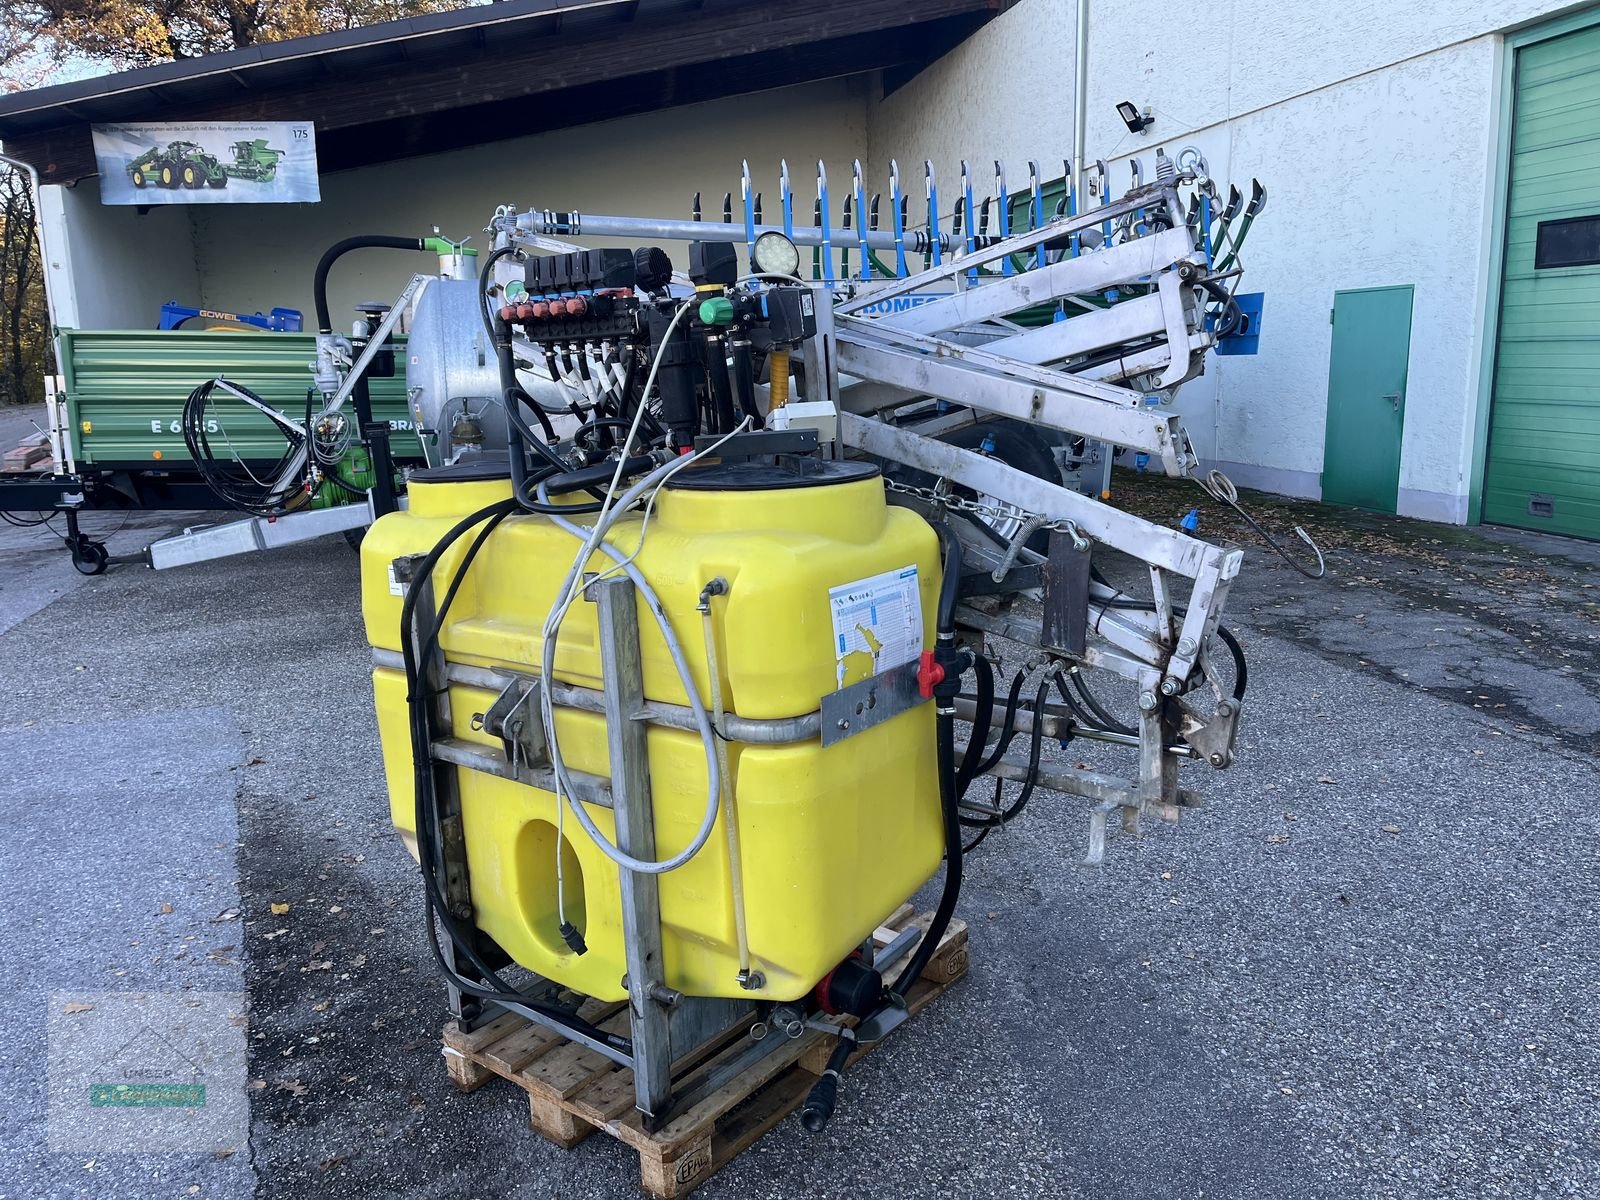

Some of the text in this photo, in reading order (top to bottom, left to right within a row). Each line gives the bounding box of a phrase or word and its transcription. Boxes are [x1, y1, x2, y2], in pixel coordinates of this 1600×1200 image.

[292, 129, 308, 139] 175
[151, 420, 162, 433] E
[681, 1157, 708, 1180] EPAL
